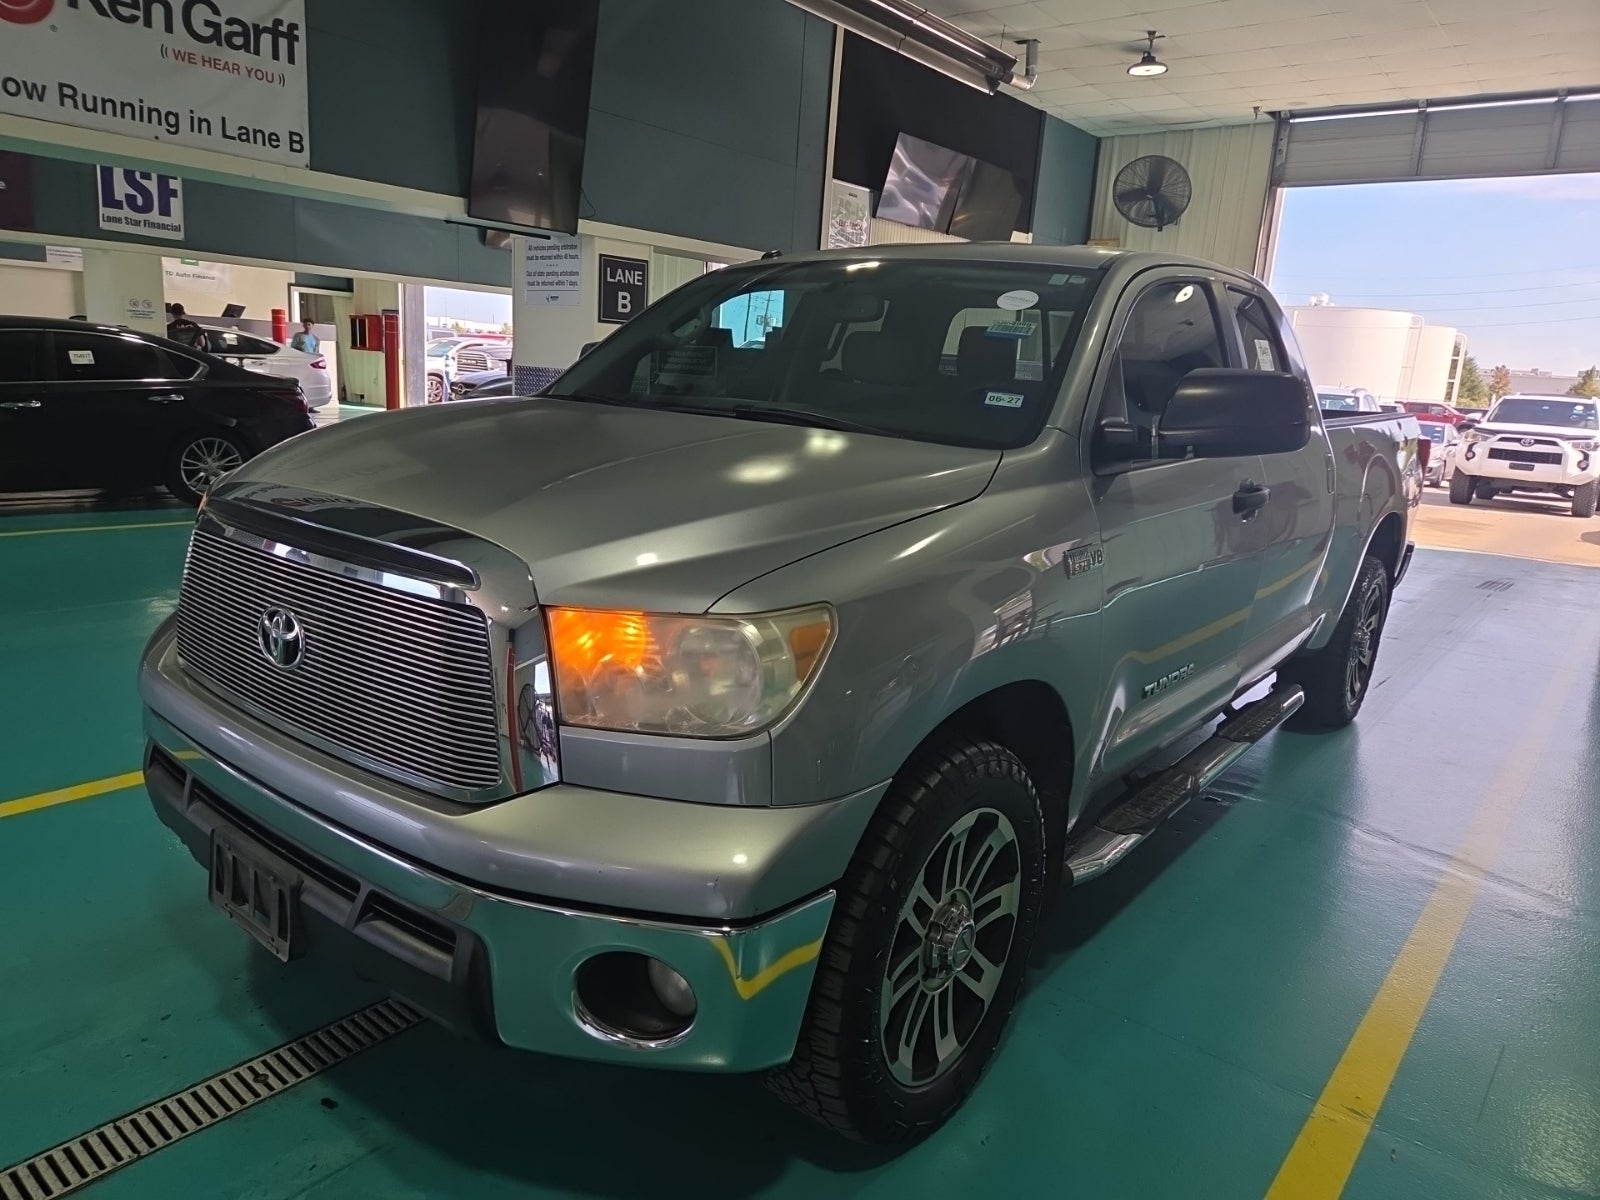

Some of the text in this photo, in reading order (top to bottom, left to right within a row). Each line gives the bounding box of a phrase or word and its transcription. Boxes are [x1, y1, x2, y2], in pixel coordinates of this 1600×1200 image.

[66, 0, 300, 66] en Garff
[172, 48, 275, 84] WE HEAR YOU
[1, 76, 305, 154] ow Running in Lane B
[100, 165, 179, 217] LSF
[102, 213, 182, 233] Lone Star Financial
[606, 267, 643, 286] LANE
[617, 291, 632, 313] B
[1143, 664, 1195, 698] TUNDRA
